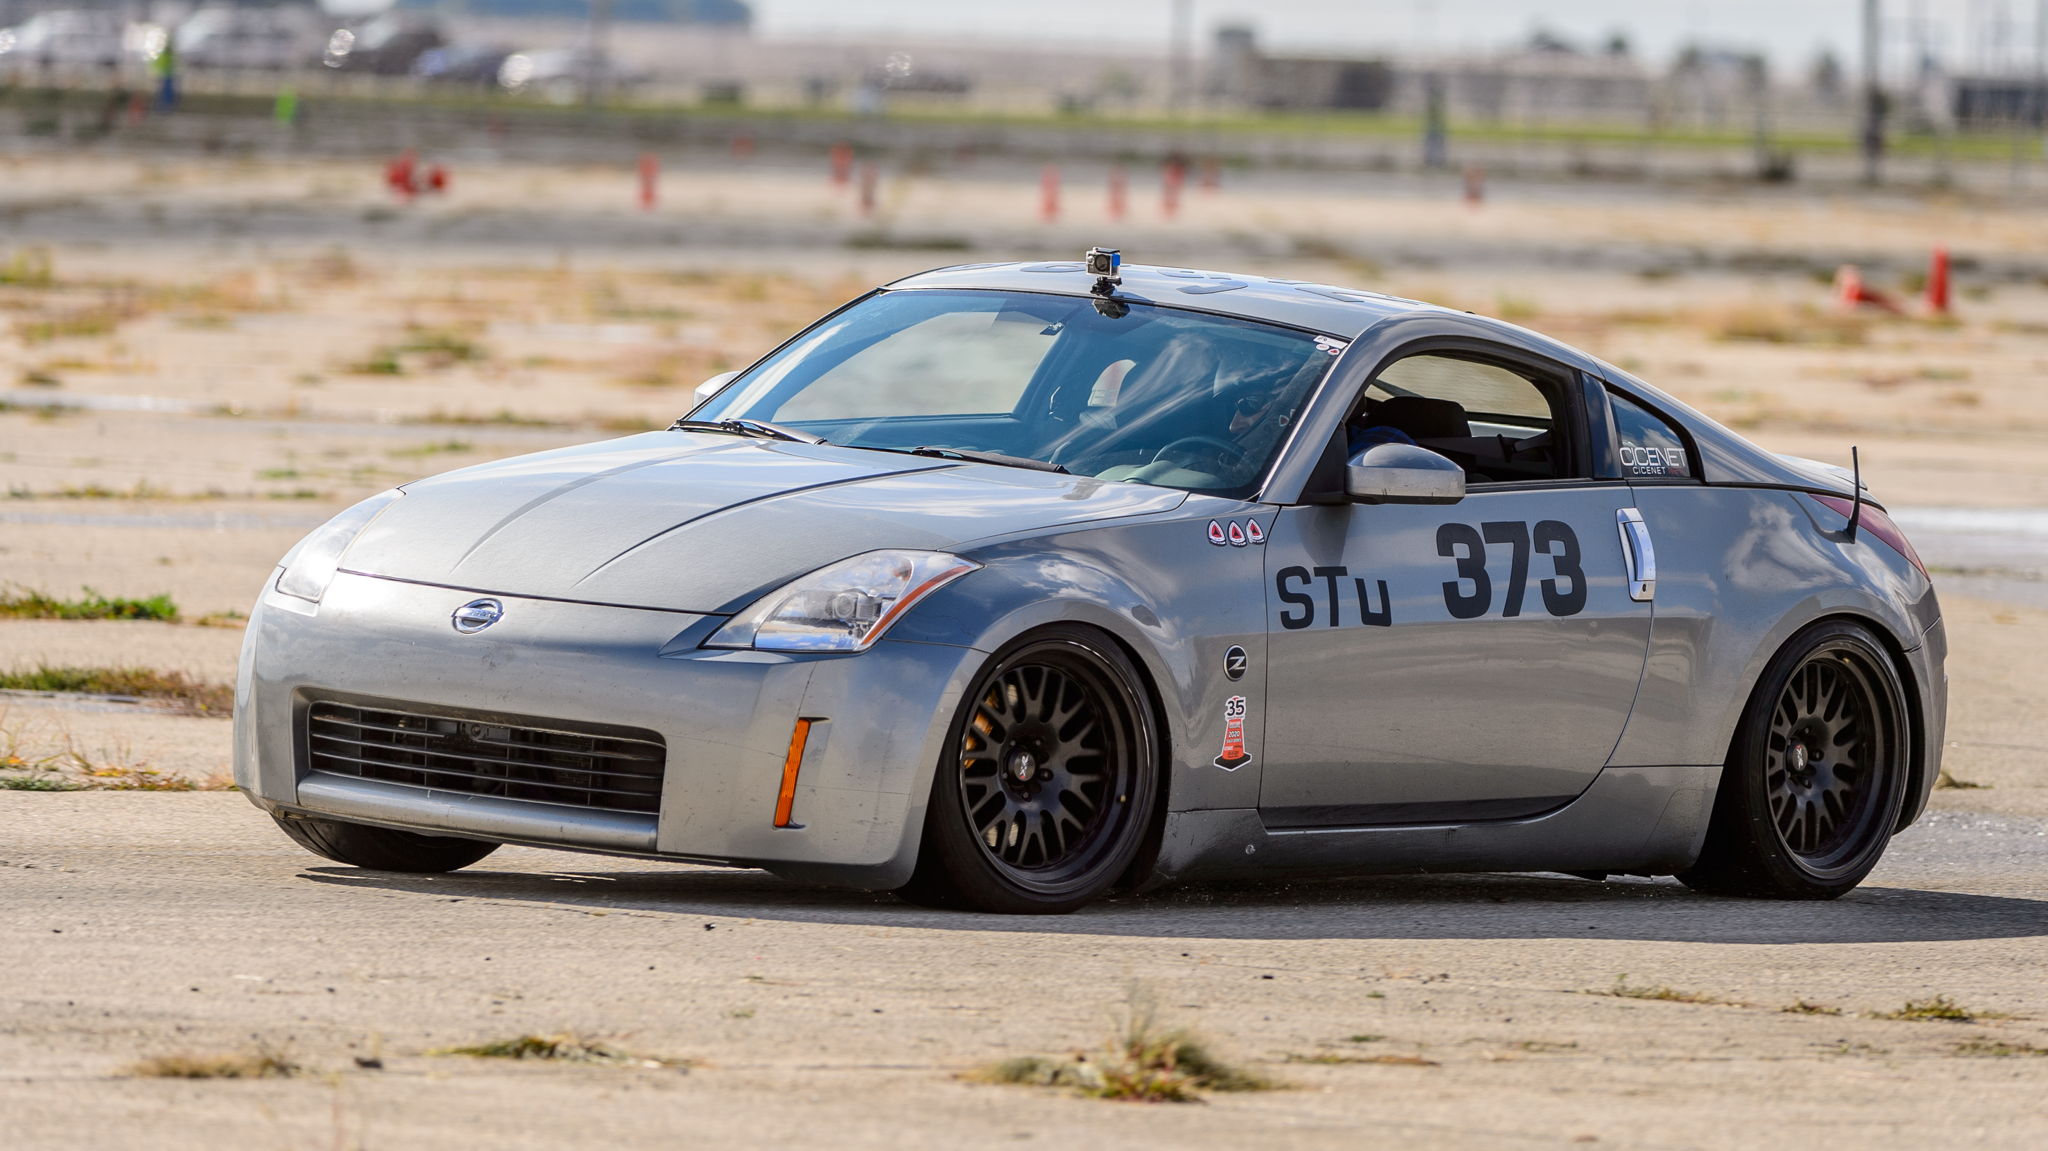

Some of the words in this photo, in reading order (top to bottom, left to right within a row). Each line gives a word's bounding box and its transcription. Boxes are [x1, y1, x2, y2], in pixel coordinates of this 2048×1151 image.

[1620, 448, 1685, 466] CICENET
[1436, 520, 1587, 619] 373
[1228, 656, 1246, 671] Z
[1227, 700, 1244, 716] 35
